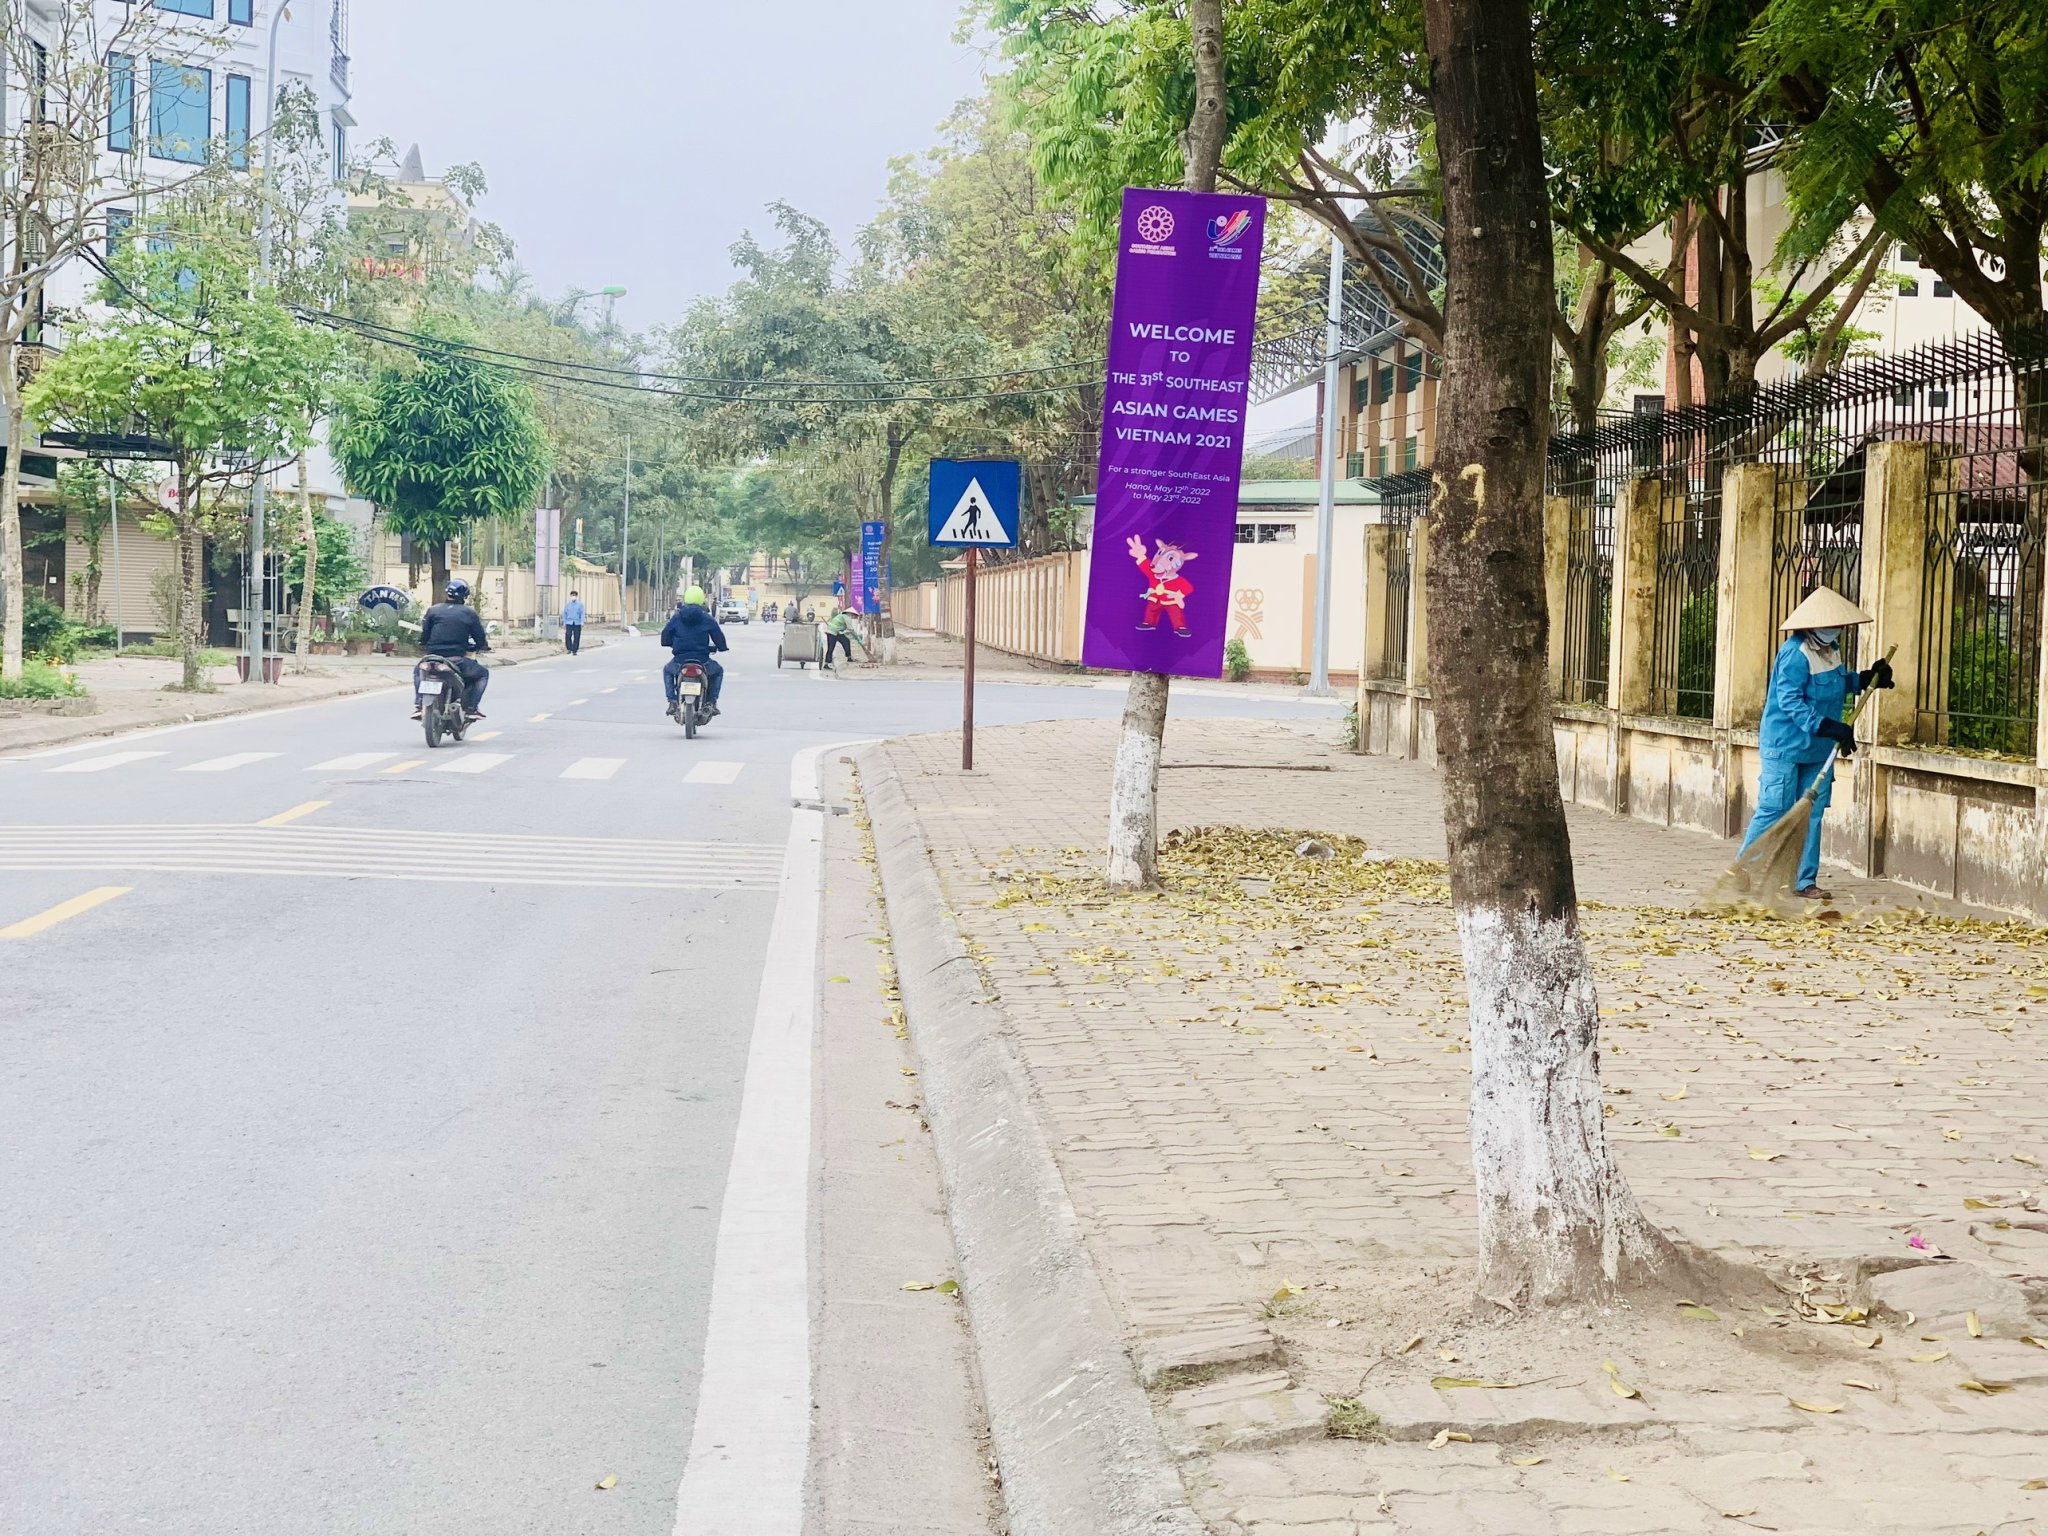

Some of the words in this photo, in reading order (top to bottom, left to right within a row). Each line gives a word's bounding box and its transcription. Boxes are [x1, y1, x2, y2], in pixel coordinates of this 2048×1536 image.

[1129, 322, 1236, 345] WELCOME
[1169, 350, 1191, 363] TO
[1112, 372, 1136, 385] THE
[1140, 371, 1164, 386] 31st
[1166, 376, 1244, 393] SOUTHEAST
[1112, 400, 1168, 418] ASIAN
[1173, 405, 1238, 423] GAMES
[1115, 427, 1192, 445] VIETNAM
[1195, 434, 1231, 448] 2021
[1108, 465, 1121, 473] For
[1130, 467, 1166, 478] stronger
[1168, 470, 1211, 481] SouthEast
[1212, 474, 1231, 482] Asia
[1125, 482, 1152, 491] Hanoi,
[1154, 485, 1173, 493] May
[1190, 487, 1211, 496] 2022
[1133, 492, 1142, 500] to
[1143, 493, 1162, 503] May
[1180, 497, 1201, 505] 2022
